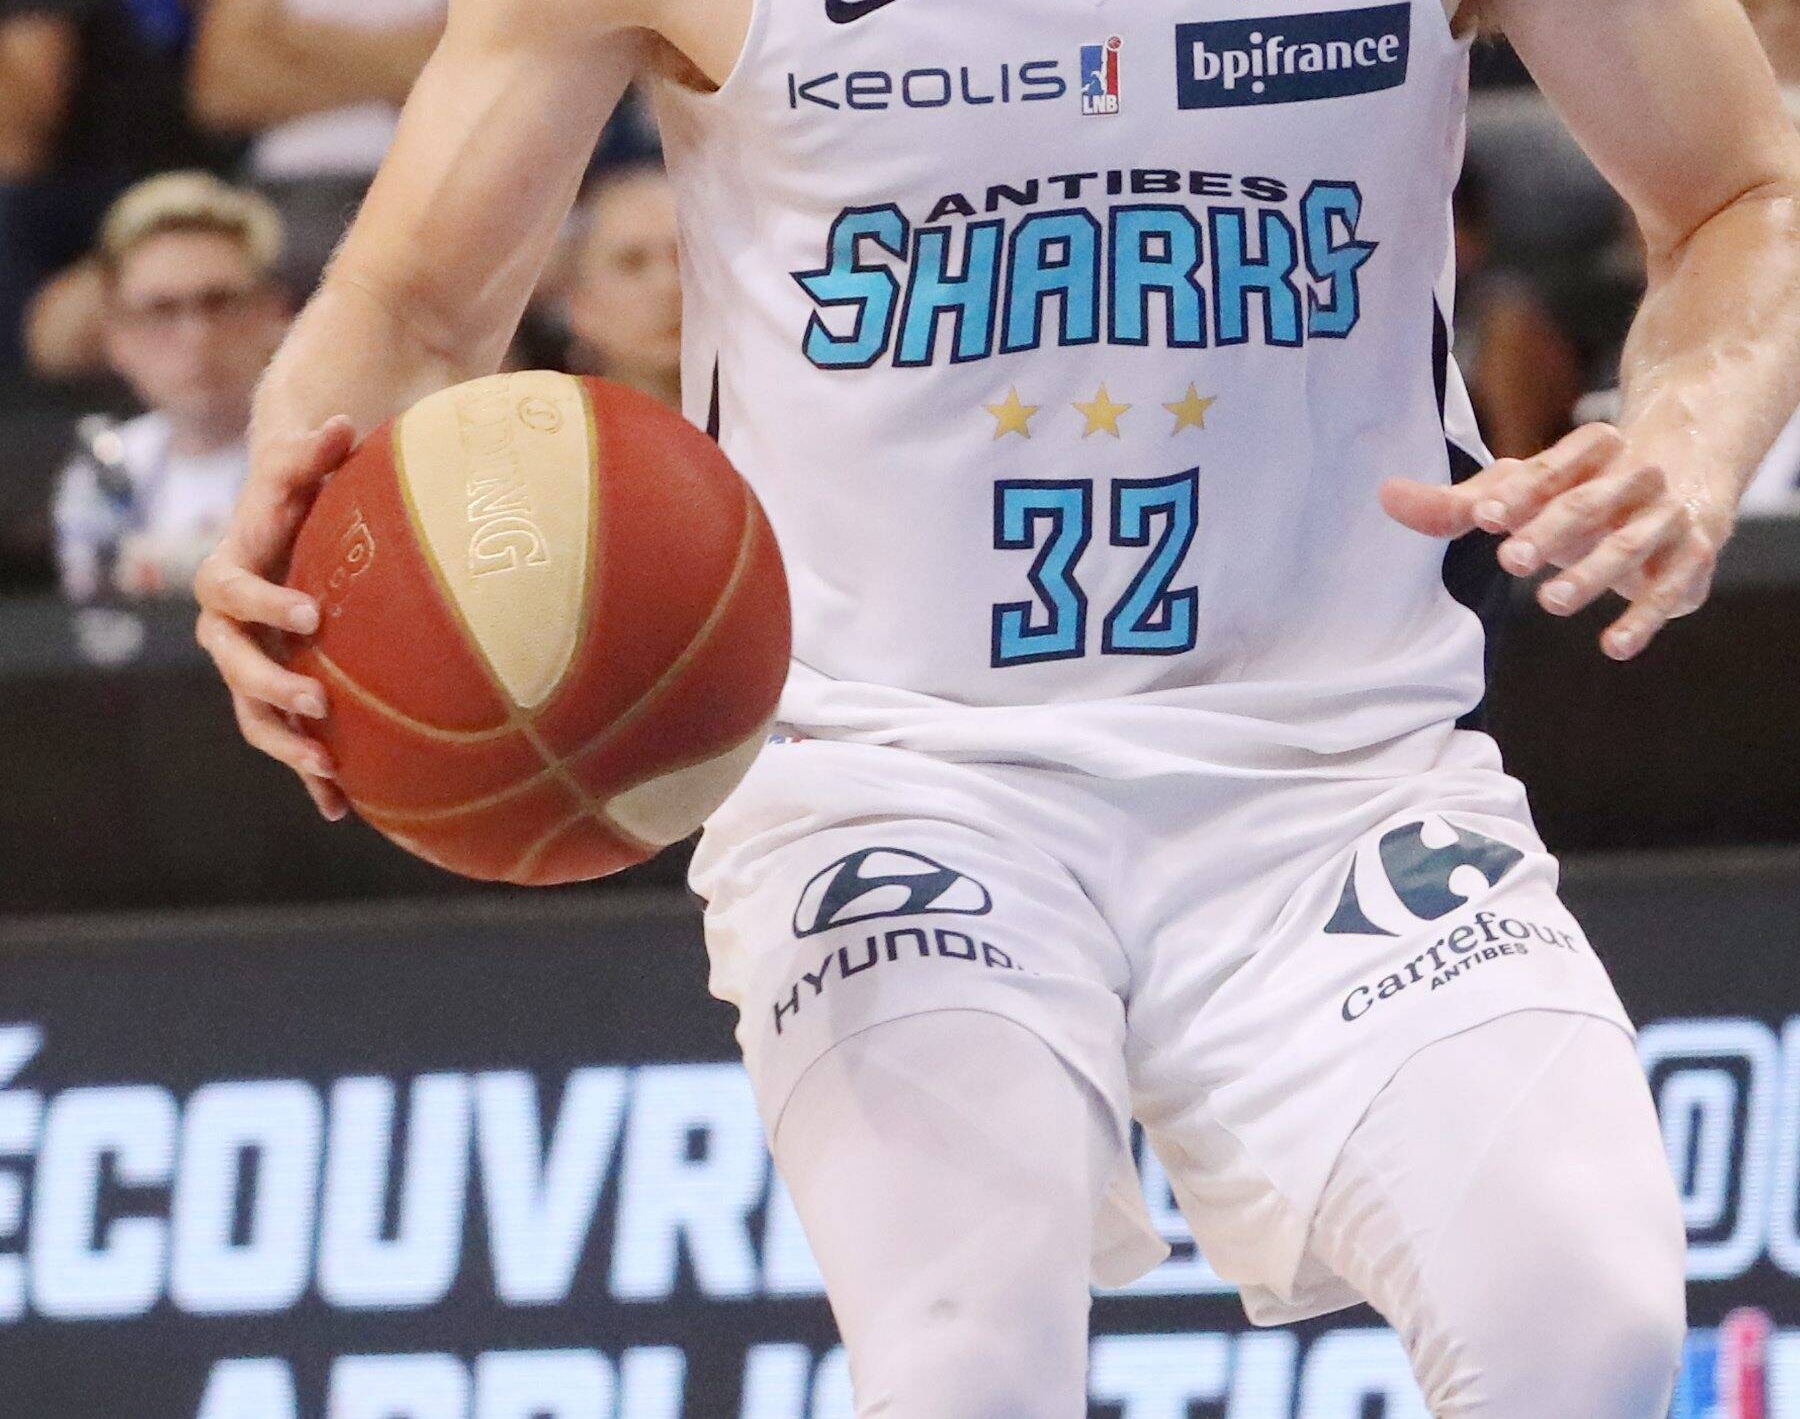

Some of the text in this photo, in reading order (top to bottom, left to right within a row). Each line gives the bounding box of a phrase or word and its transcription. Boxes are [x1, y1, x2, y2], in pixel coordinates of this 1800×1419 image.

[1192, 31, 1400, 94] bpifrance
[1082, 93, 1120, 115] LNB
[925, 168, 1289, 225] ANTIBES
[789, 180, 1379, 371] SHARKS
[991, 467, 1200, 668] 32
[1341, 911, 1580, 1022] Carrefour
[1431, 942, 1529, 991] ANTIBES
